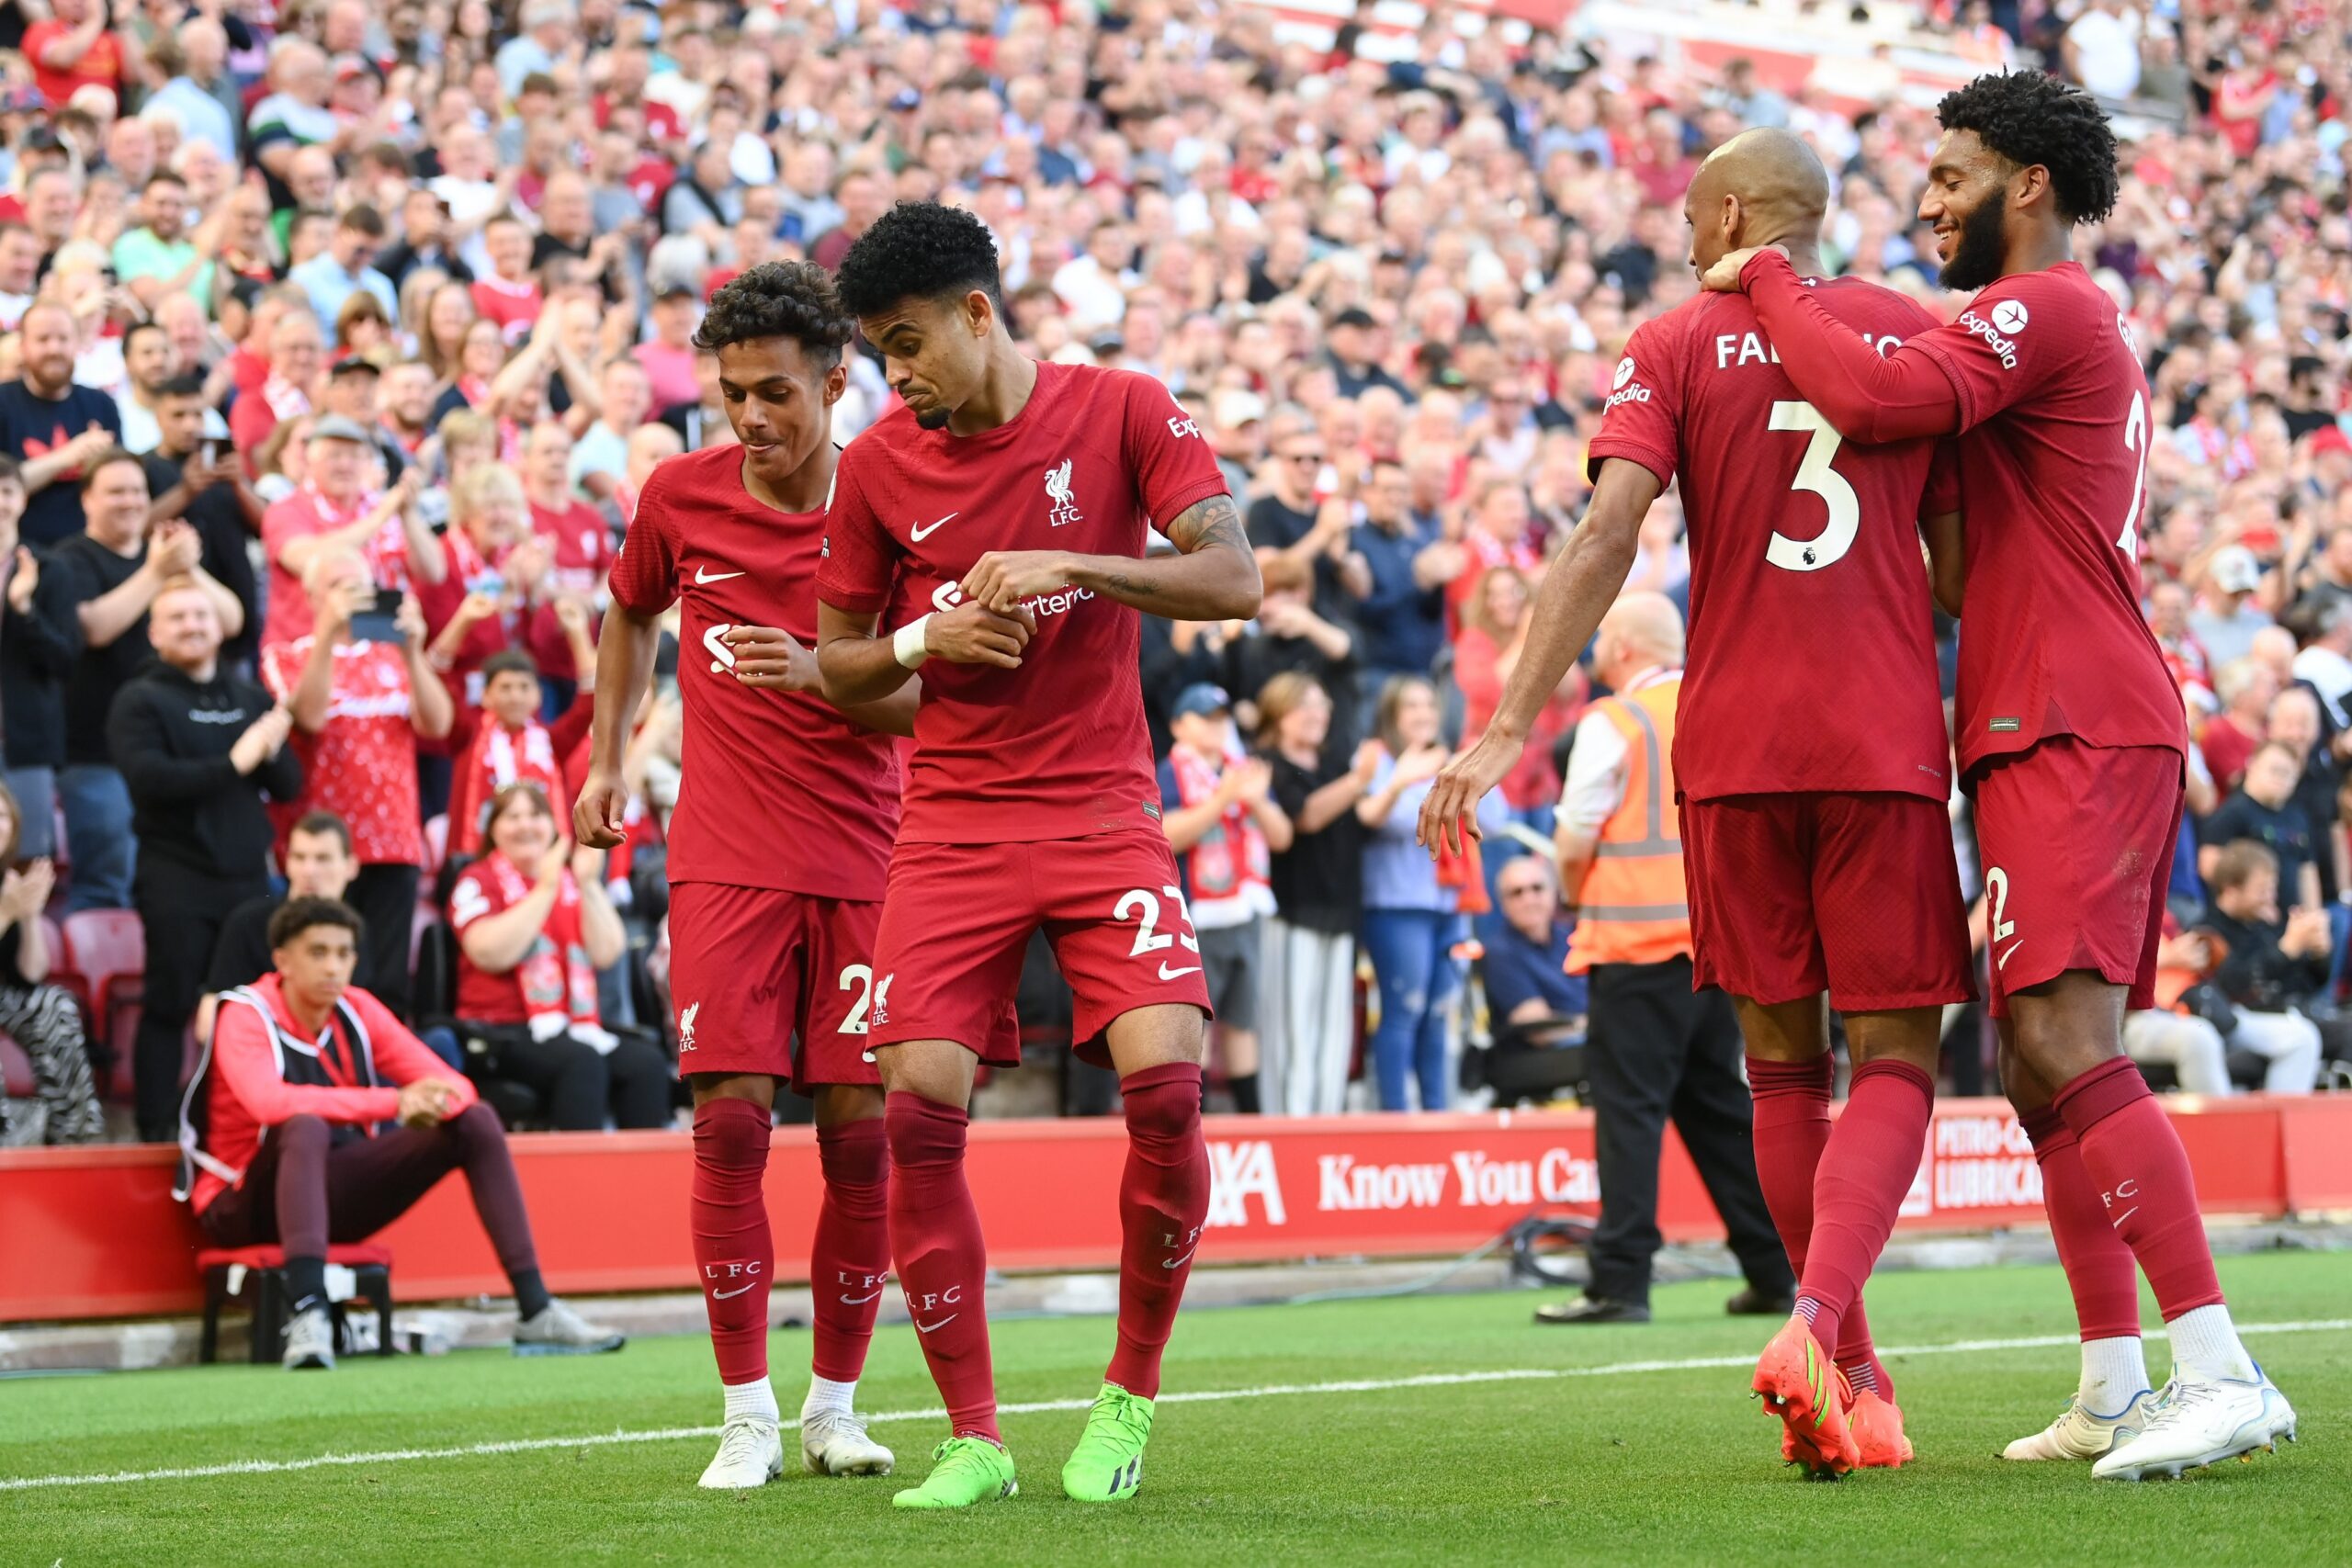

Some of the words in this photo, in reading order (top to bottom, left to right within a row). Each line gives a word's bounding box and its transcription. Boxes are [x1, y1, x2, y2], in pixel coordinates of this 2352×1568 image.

[1167, 416, 1199, 439] Exp
[1602, 382, 1651, 417] pedia
[1765, 400, 1860, 571] 3
[1113, 886, 1200, 957] 23
[1986, 867, 2015, 943] 2
[1204, 1141, 1288, 1226] XA
[1317, 1154, 1448, 1211] Know
[1451, 1150, 1534, 1206] You
[1936, 1157, 2044, 1208] LUBRICA
